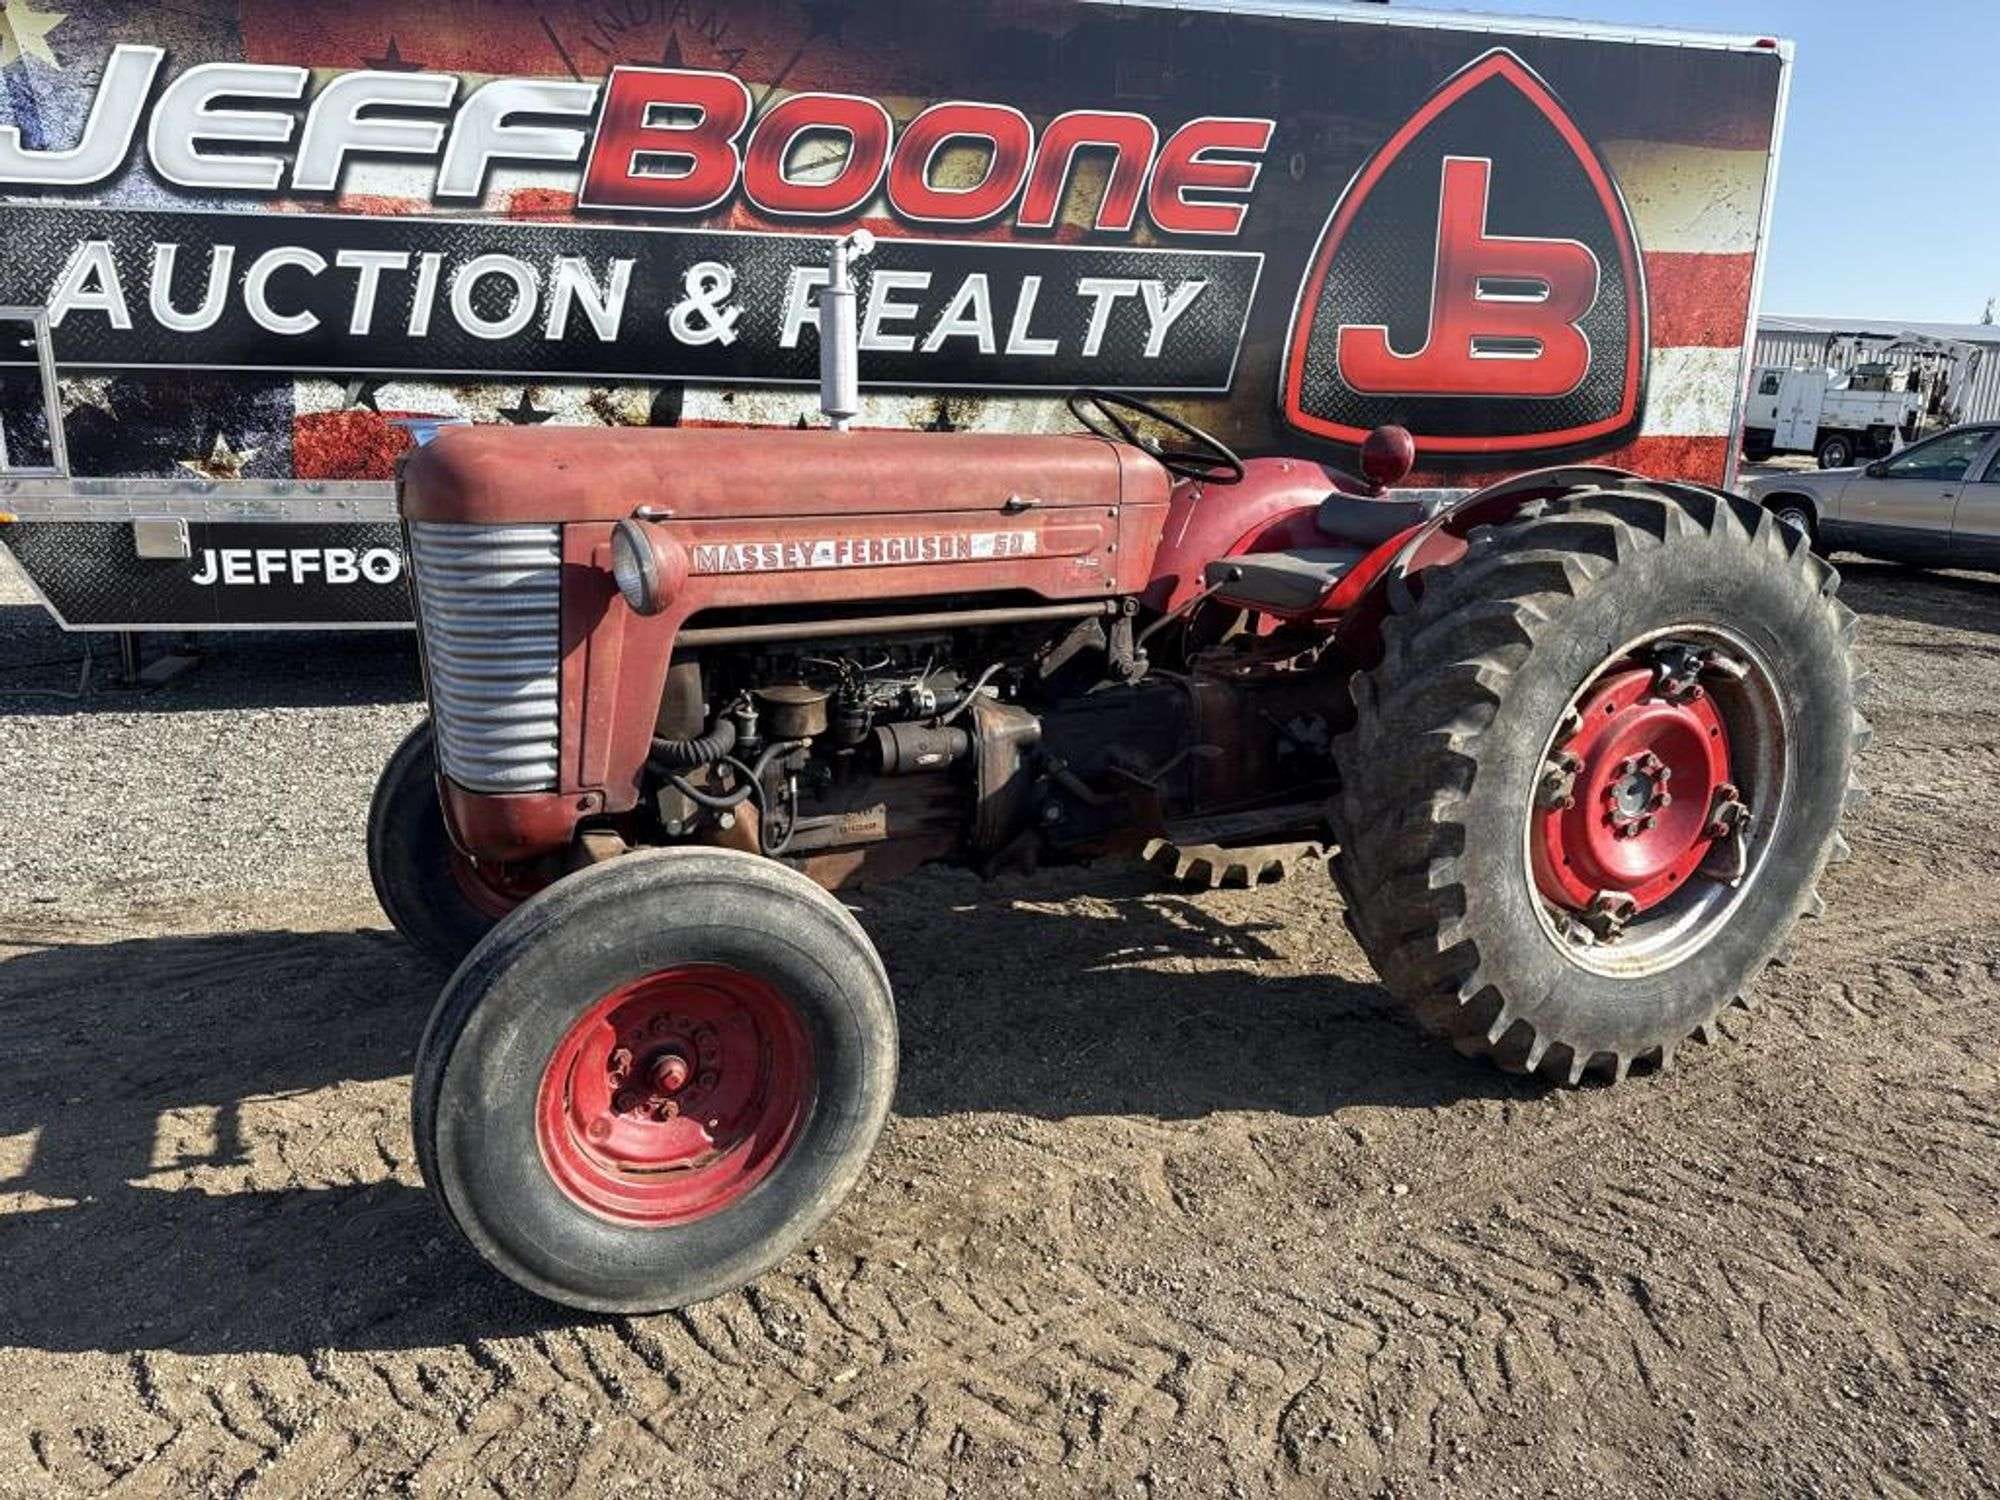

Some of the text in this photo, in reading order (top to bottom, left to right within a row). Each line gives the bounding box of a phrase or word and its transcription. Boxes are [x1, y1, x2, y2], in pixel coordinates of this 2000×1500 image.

[48, 240, 1206, 357] AUCTION & REALTY
